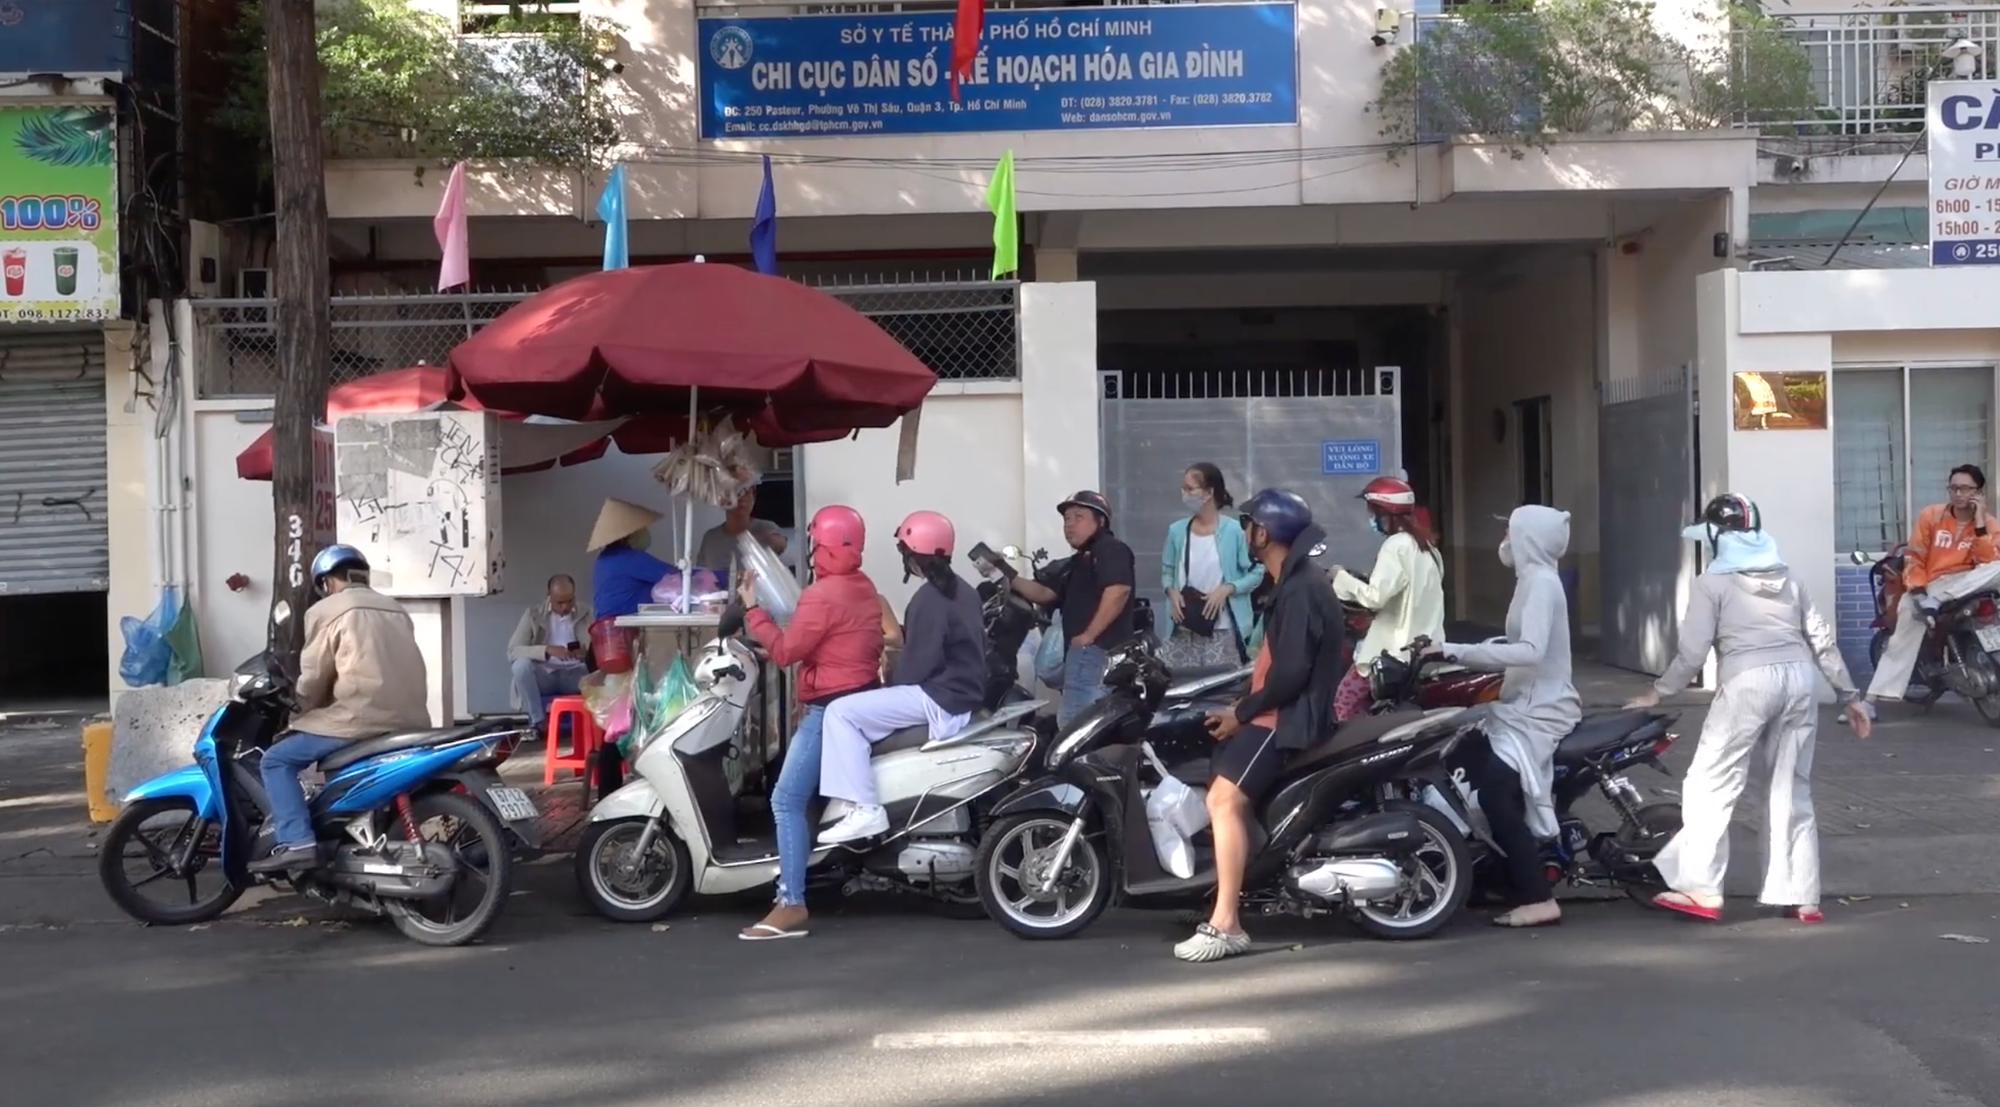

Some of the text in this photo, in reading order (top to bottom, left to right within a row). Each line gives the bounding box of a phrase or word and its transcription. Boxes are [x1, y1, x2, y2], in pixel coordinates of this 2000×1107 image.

[840, 16, 1152, 44] SỞ Y TẾ THÀ PHỐ HỒ CHÍ MINH
[751, 61, 792, 91] CHI
[798, 60, 846, 97] CỤC
[852, 53, 900, 87] DÂN
[907, 46, 938, 87] SỐ
[996, 54, 1077, 91] HOẠCH
[1084, 46, 1133, 82] HÓA
[1139, 51, 1180, 80] GIA
[1185, 43, 1244, 79] ĐÌNH
[744, 106, 763, 117] 250
[765, 105, 805, 117] Pasteur,
[907, 101, 932, 114] Quận
[934, 101, 945, 113] 3,
[948, 101, 964, 113] Tp.
[984, 99, 1000, 110] Chí
[1003, 98, 1027, 110] Minh
[1080, 96, 1105, 109] (028)
[1108, 95, 1158, 107] 3820.3781
[1170, 94, 1190, 105] Fax:
[1193, 93, 1219, 106] (028)
[1221, 92, 1272, 104] 3820.3782
[1060, 111, 1171, 123] Web: dansohcm.gov.vn
[724, 121, 756, 132] Email:
[1975, 142, 2000, 159] P
[1944, 174, 1981, 191] GIỜ
[0, 194, 101, 232] 100%
[1936, 199, 1970, 214] 6h00
[1937, 220, 1979, 236] 15h00
[1975, 243, 2000, 258] 25
[1328, 444, 1374, 453] VUI LÒNG
[1328, 452, 1360, 462] XUỐNG
[1356, 461, 1370, 470] BỘ
